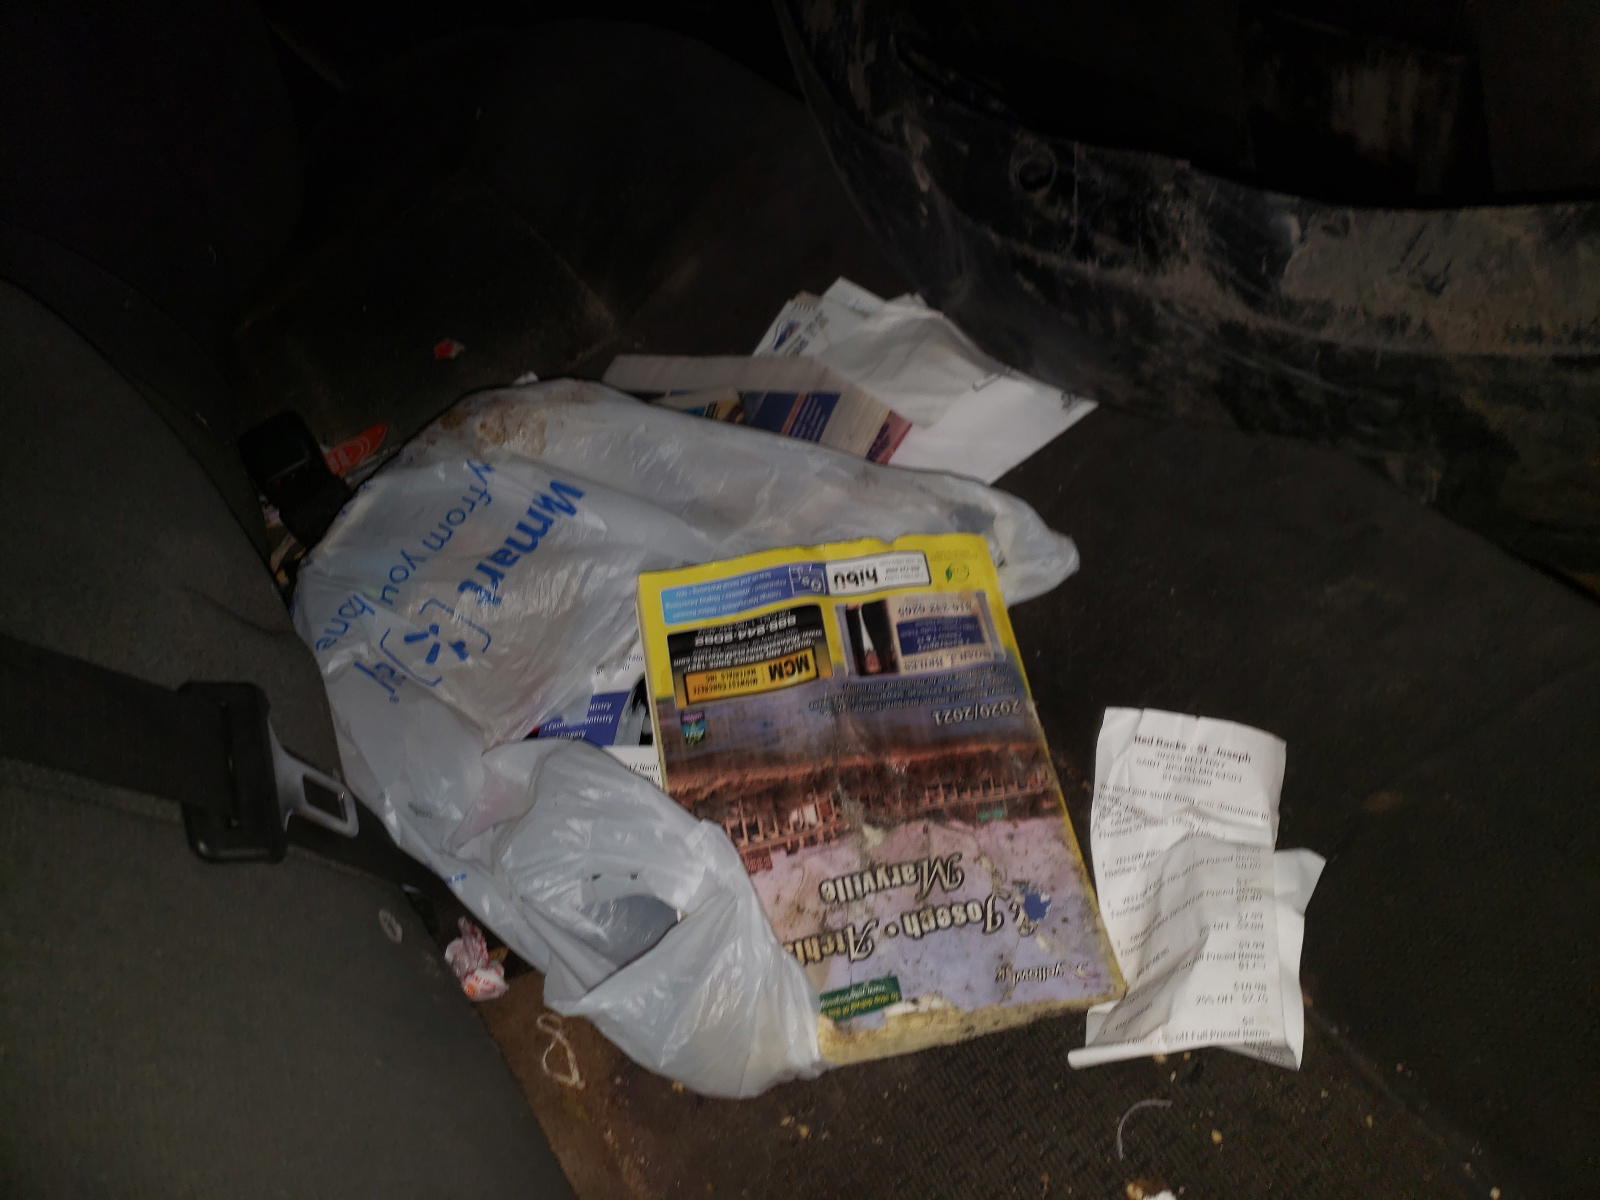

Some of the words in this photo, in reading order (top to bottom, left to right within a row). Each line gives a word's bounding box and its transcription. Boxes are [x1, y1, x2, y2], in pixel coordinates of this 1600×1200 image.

[422, 484, 492, 551] from
[379, 549, 427, 606] you
[769, 654, 811, 682] MCM
[934, 700, 1022, 726] 2020/2021
[819, 852, 965, 905] Maryville
[900, 893, 1005, 940] Joseph
